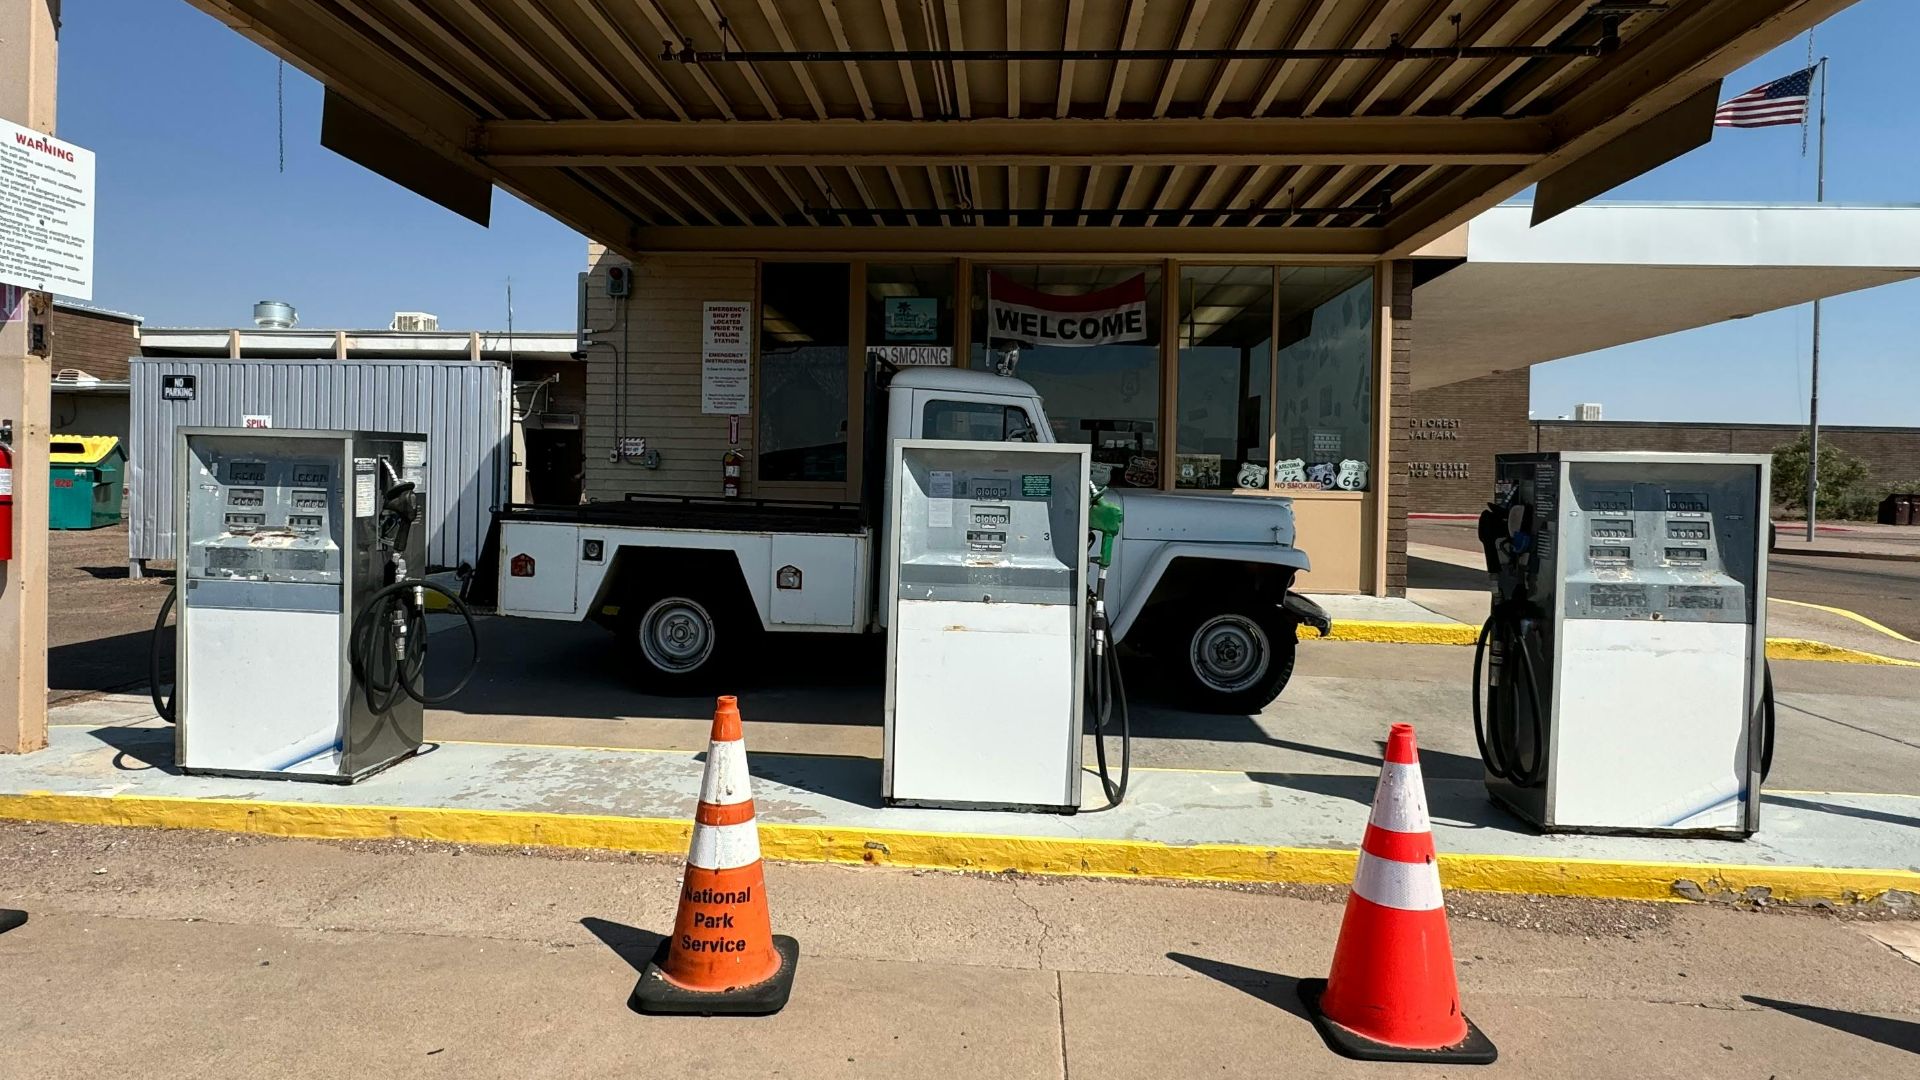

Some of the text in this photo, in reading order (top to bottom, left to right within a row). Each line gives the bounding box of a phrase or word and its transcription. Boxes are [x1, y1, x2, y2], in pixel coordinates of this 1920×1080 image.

[16, 132, 74, 163] WARNING
[995, 308, 1143, 341] WELCOME
[891, 347, 948, 364] SMOKING
[174, 378, 184, 388] NO
[165, 388, 193, 397] PARKING
[246, 419, 268, 428] SPILL
[1420, 418, 1461, 428] FOREST
[1430, 431, 1457, 440] PARK
[1279, 462, 1300, 470] ARIZONA
[1434, 462, 1470, 470] DESERT
[1434, 470, 1470, 479] CENTER
[1241, 476, 1259, 488] 66
[1343, 476, 1360, 488] 66
[685, 886, 750, 904] National
[694, 912, 734, 928] Park
[682, 935, 746, 952] Service
